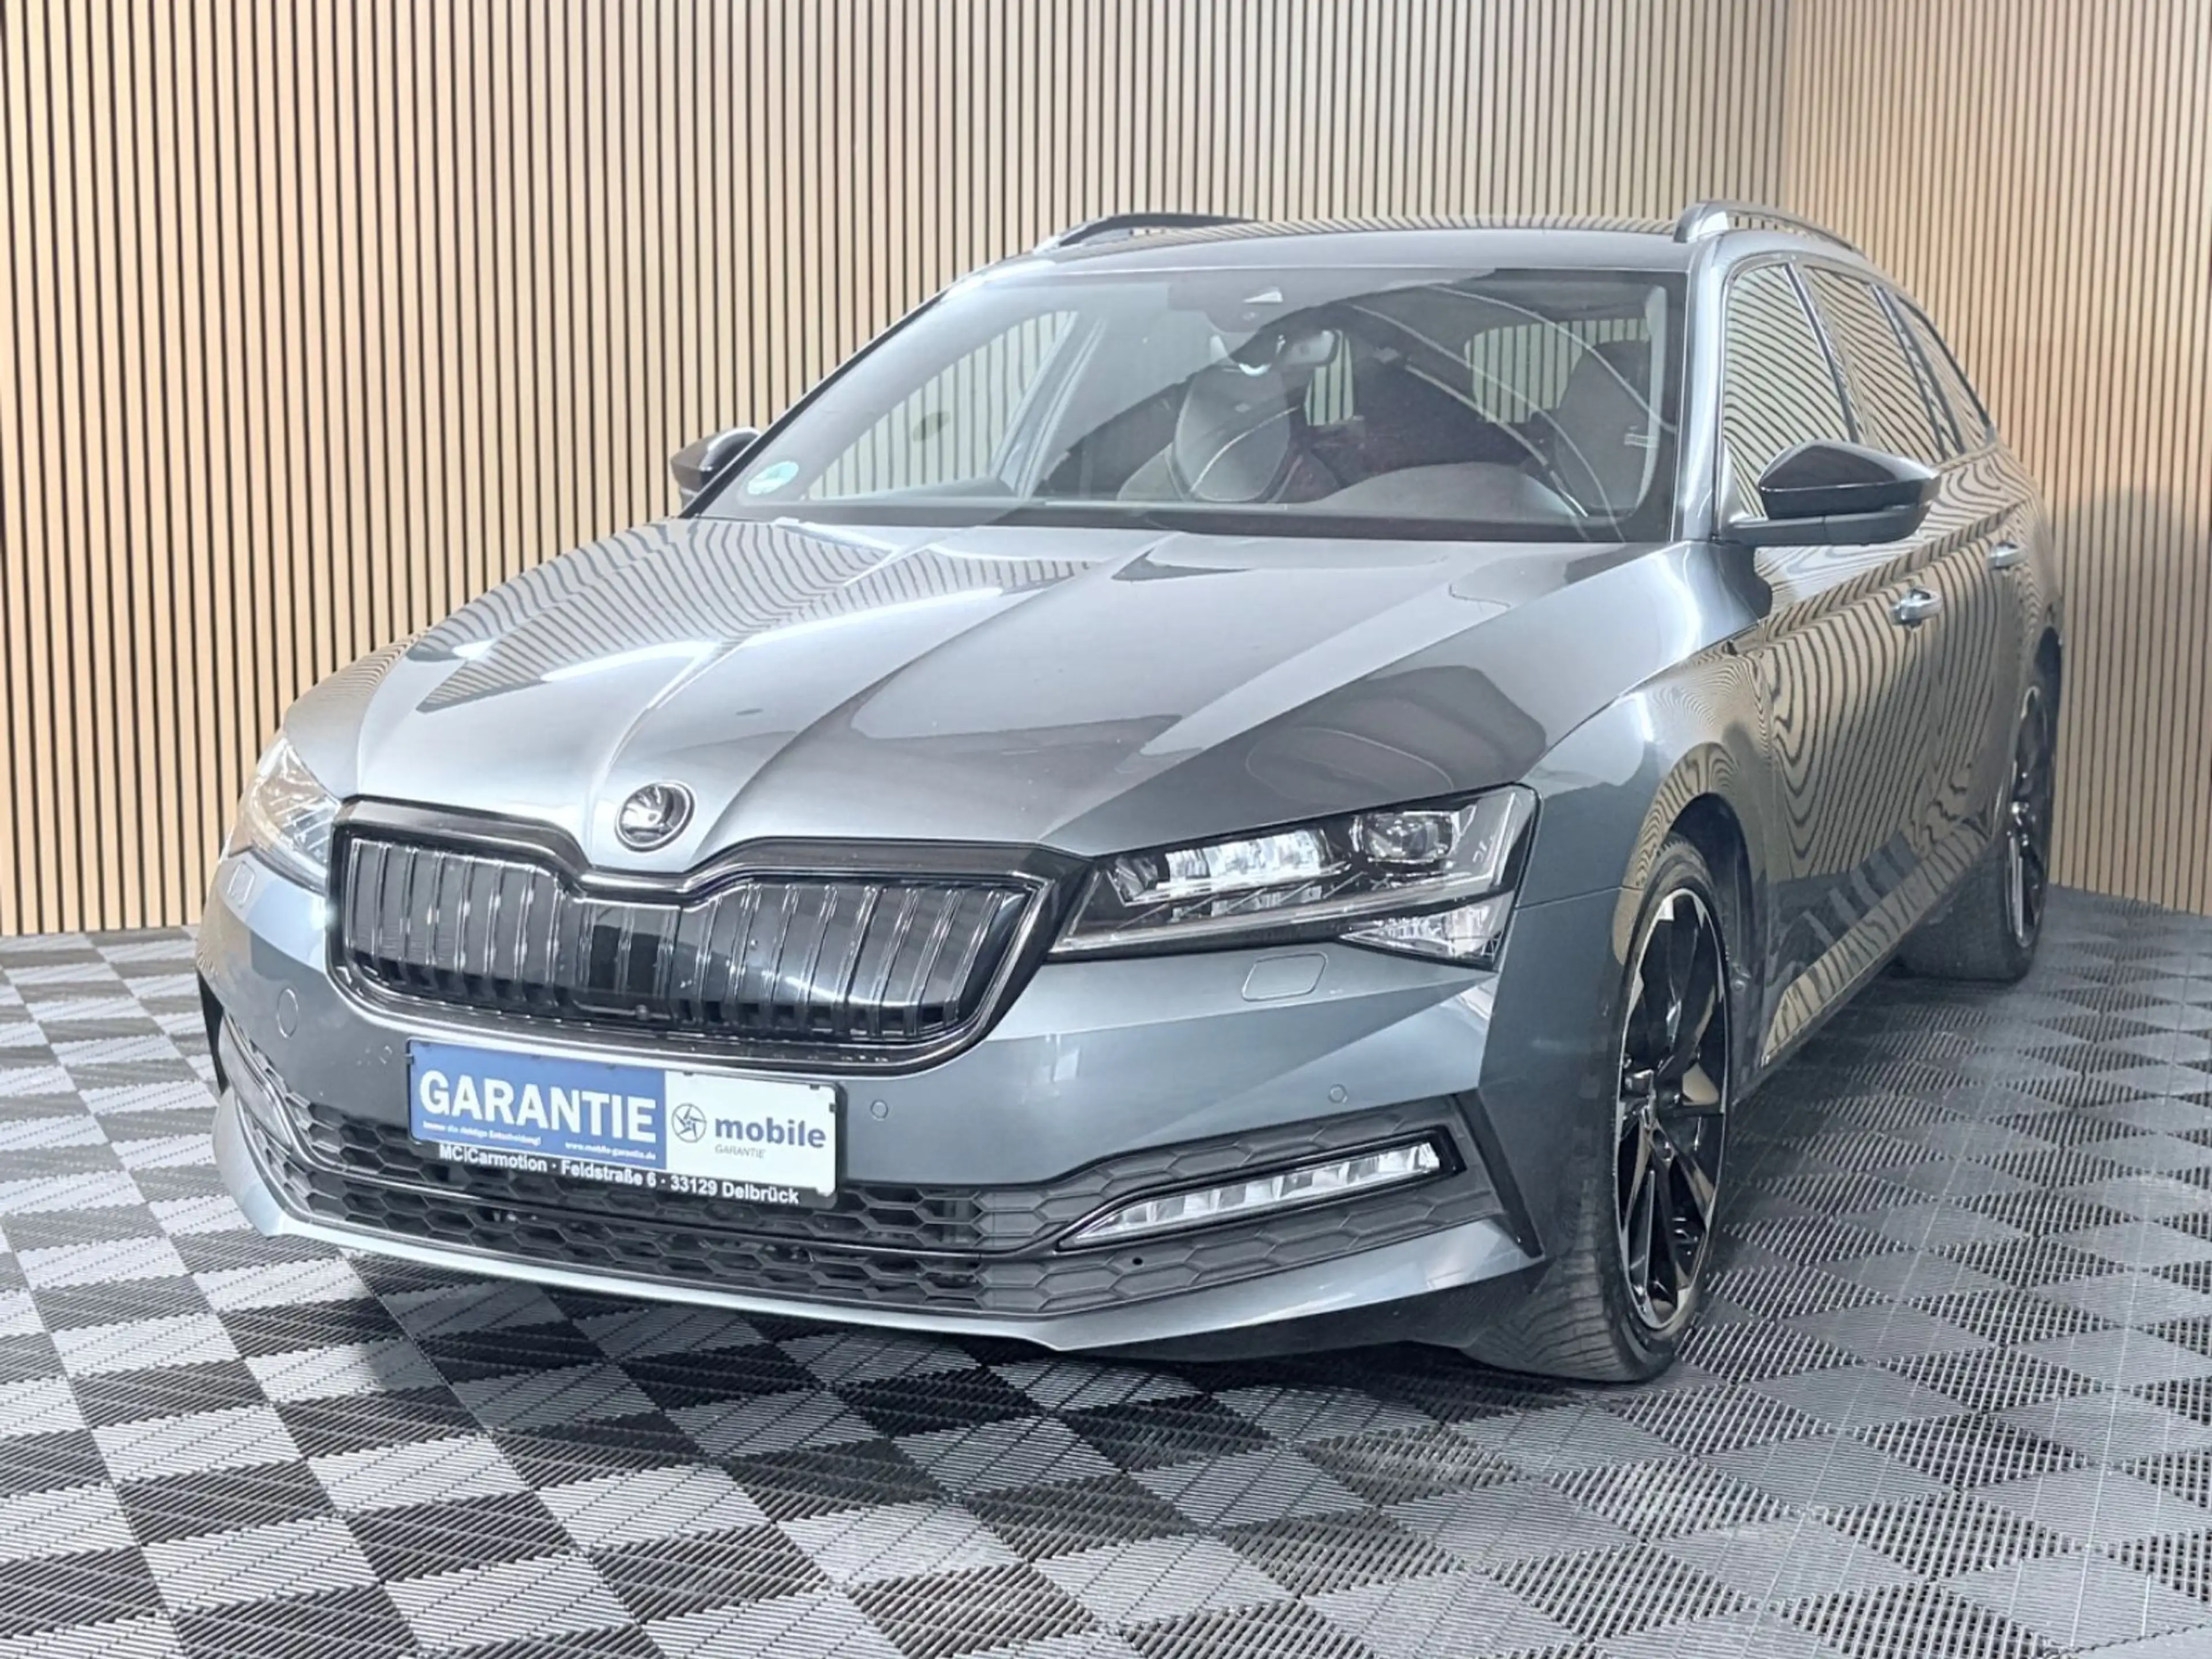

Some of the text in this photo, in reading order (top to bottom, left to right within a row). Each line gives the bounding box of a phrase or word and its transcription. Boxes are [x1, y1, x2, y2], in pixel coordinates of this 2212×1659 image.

[419, 1069, 656, 1143] GARANTIE
[715, 1117, 826, 1148] mobile
[715, 1143, 766, 1158] GARANTIE
[561, 1160, 643, 1186] Feldstraße
[646, 1171, 657, 1188] 6
[670, 1175, 718, 1196] 33129
[722, 1180, 800, 1205] Delbrück
